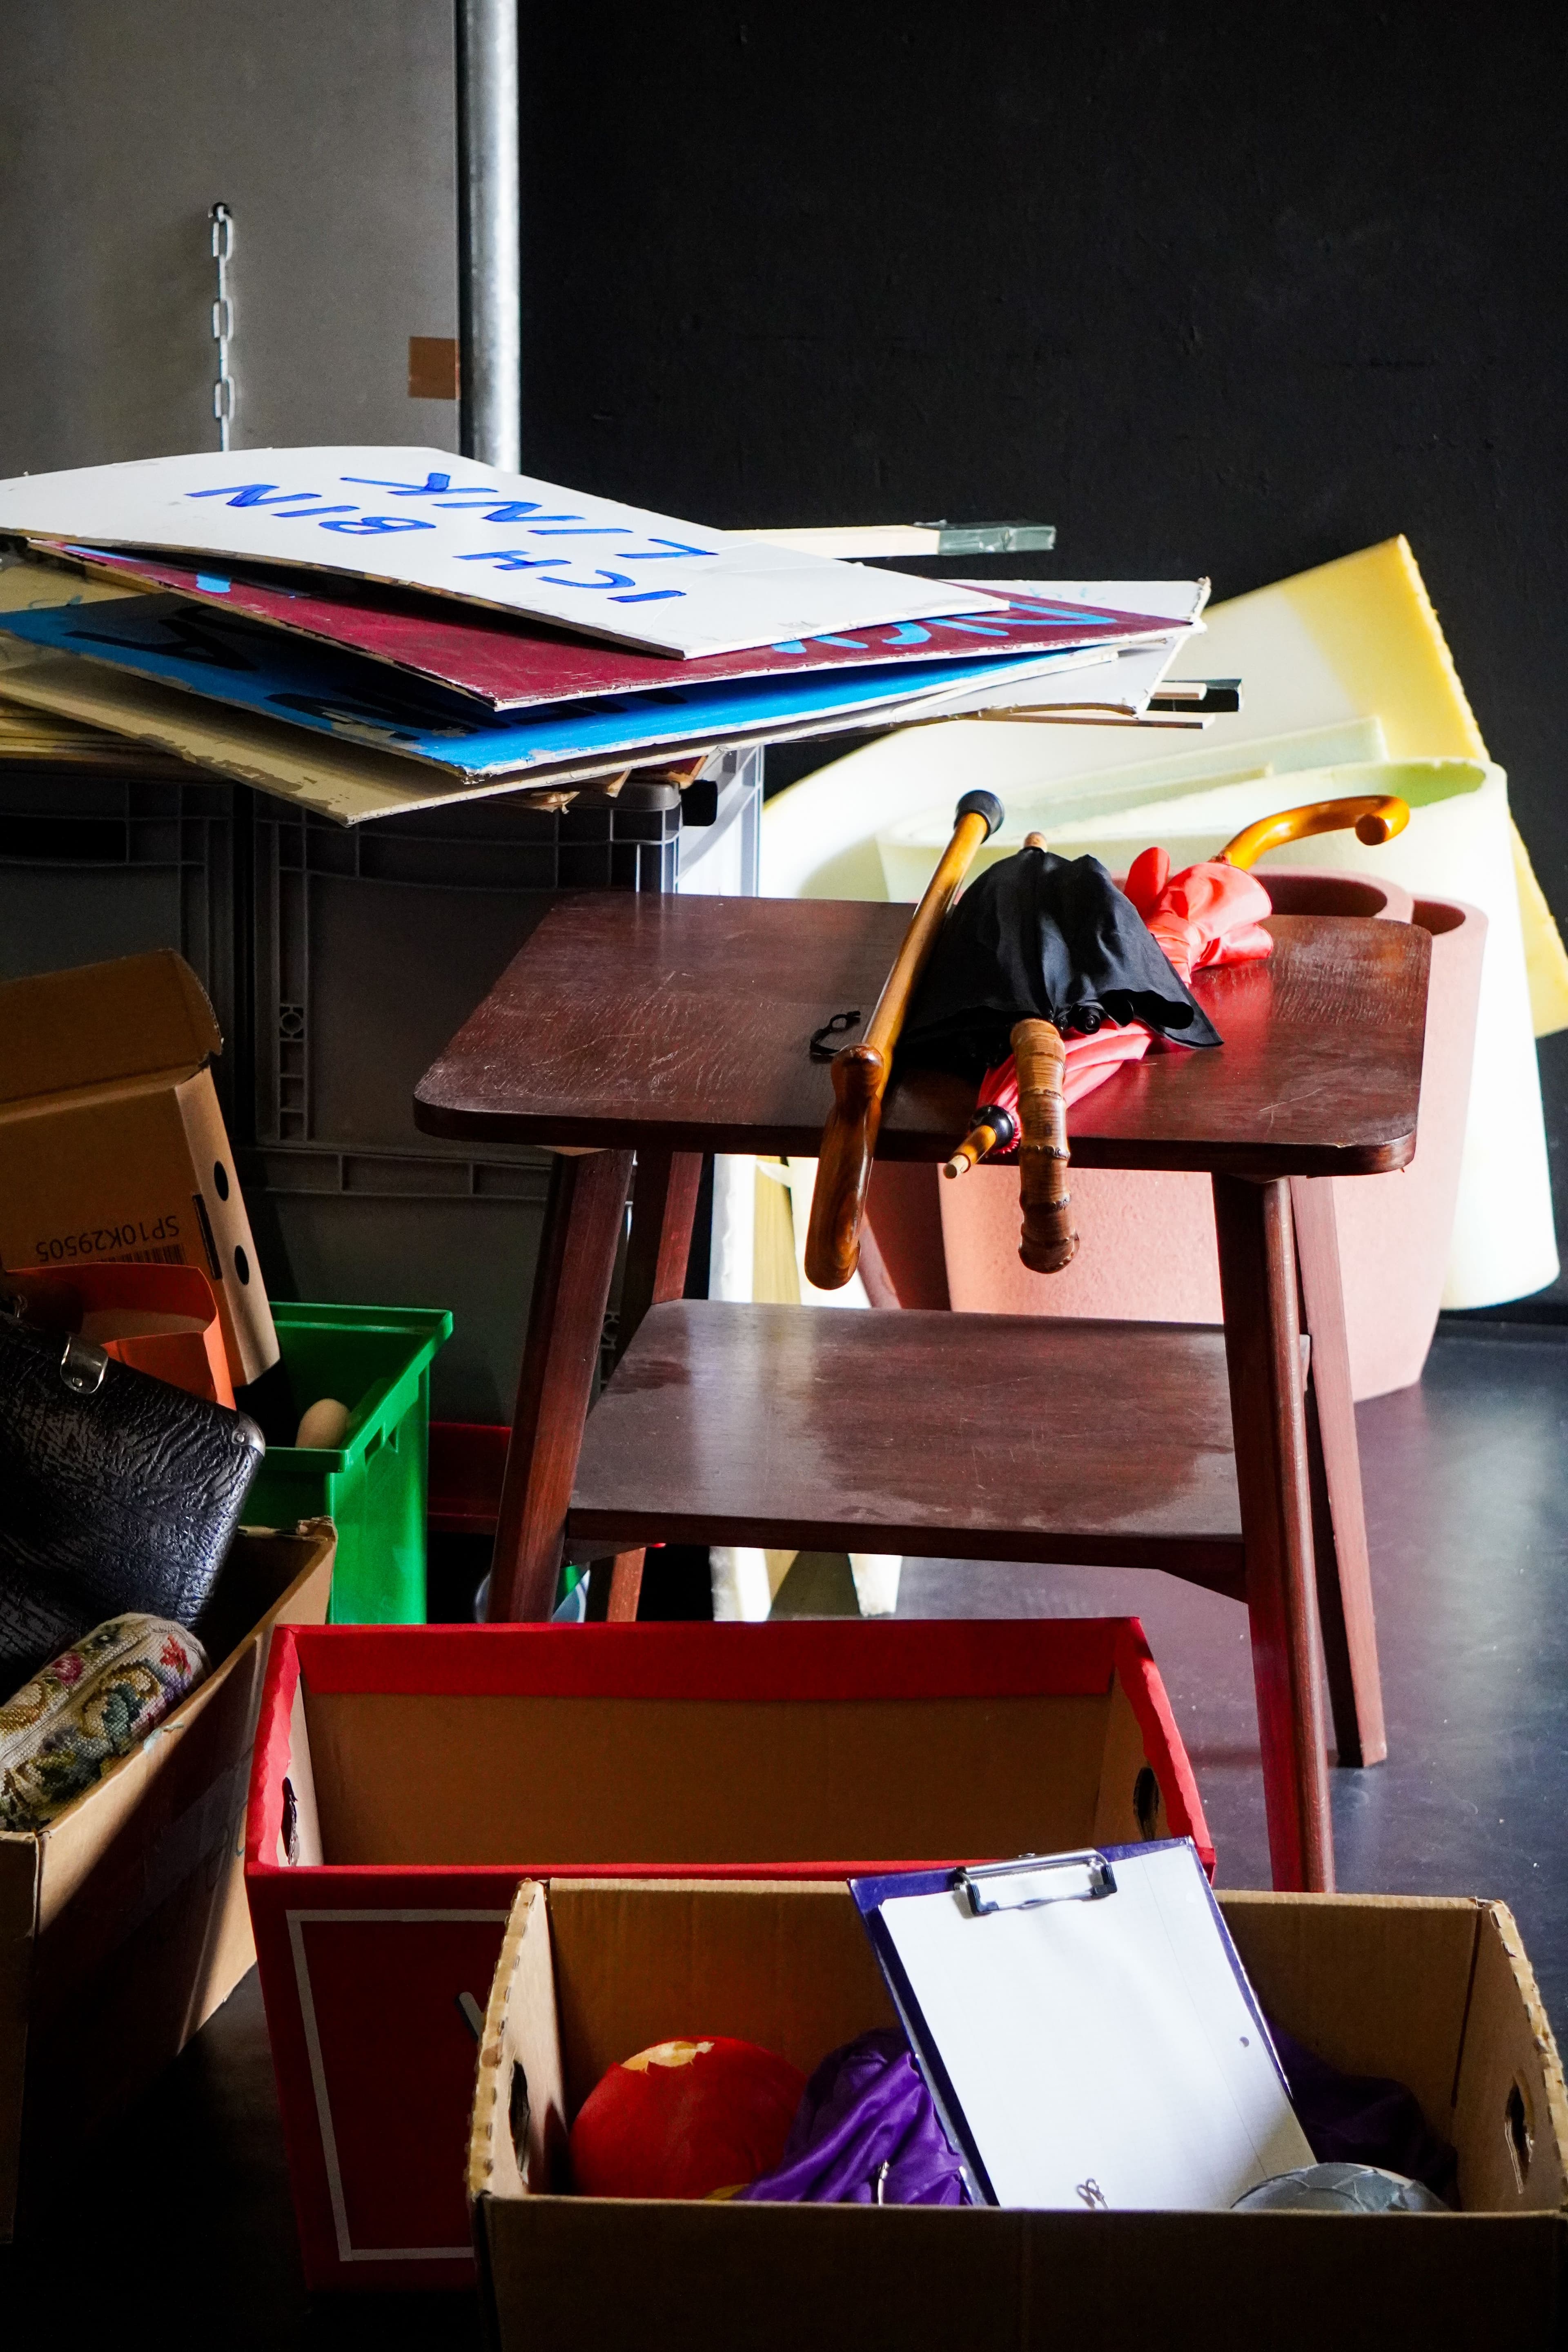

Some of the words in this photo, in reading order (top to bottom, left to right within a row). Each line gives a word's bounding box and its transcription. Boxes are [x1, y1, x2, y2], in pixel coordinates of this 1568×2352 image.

[186, 483, 437, 535] BIN
[341, 472, 718, 556] LINK
[453, 550, 687, 603] ICH
[36, 1215, 180, 1263] SP10K29505
